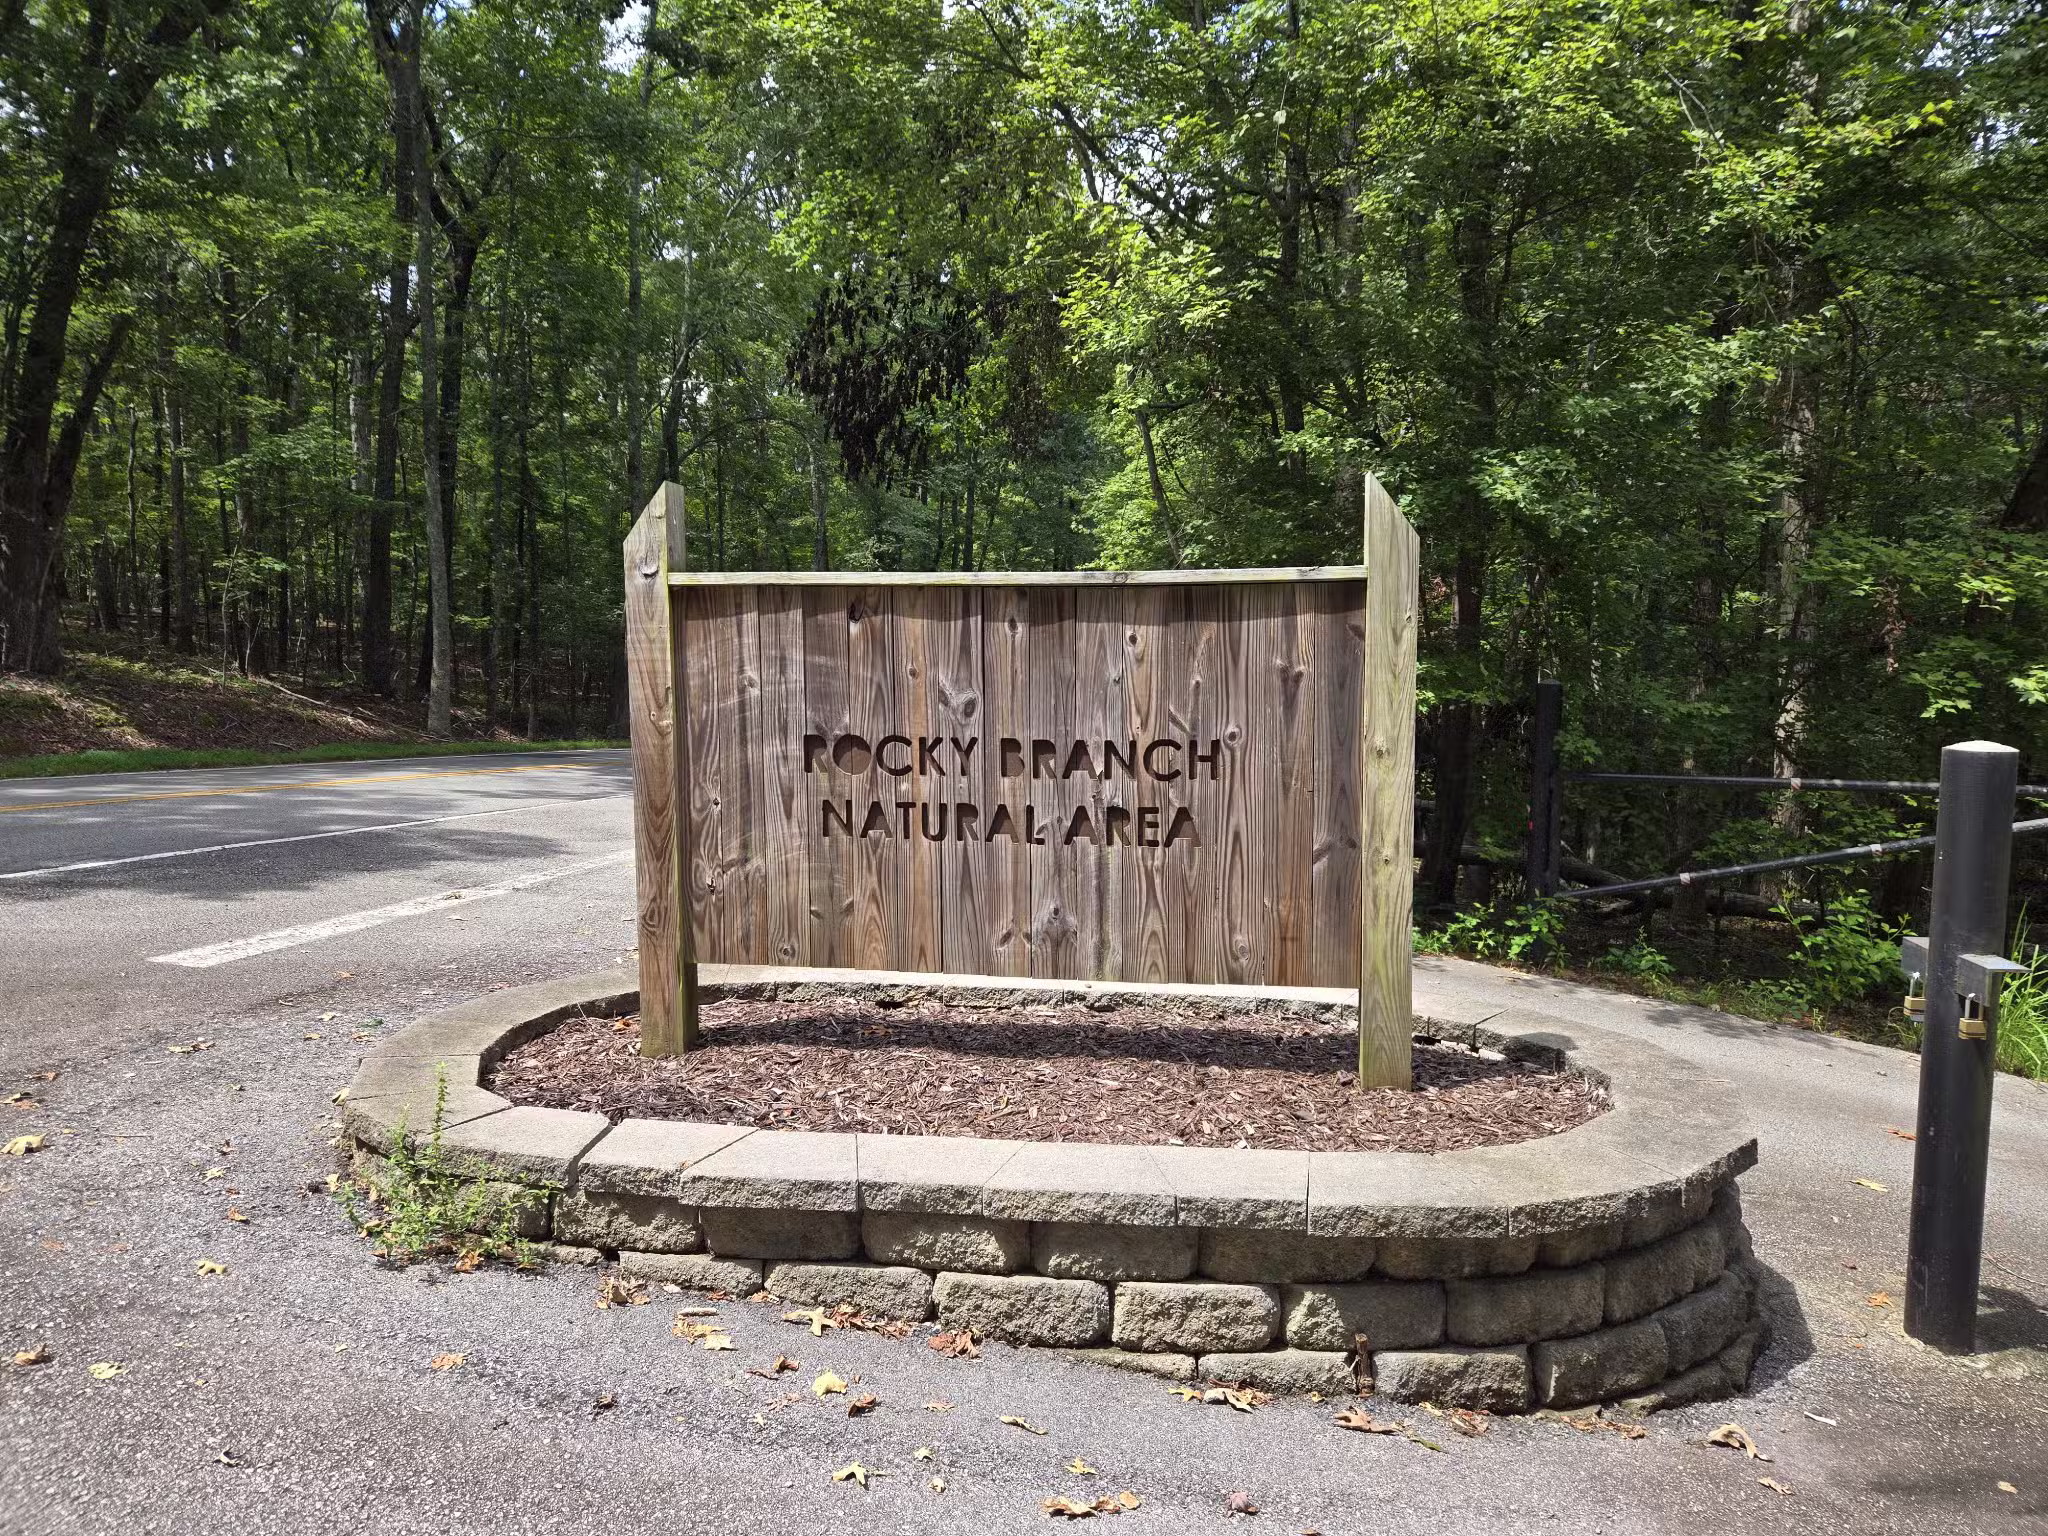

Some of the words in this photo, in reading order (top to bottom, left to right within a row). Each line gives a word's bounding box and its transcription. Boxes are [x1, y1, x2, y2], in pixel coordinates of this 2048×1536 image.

[803, 734, 978, 777] ROCKY
[1000, 738, 1220, 781] BRANCH
[822, 799, 1045, 846] NATURAL
[1063, 804, 1202, 848] AREA
